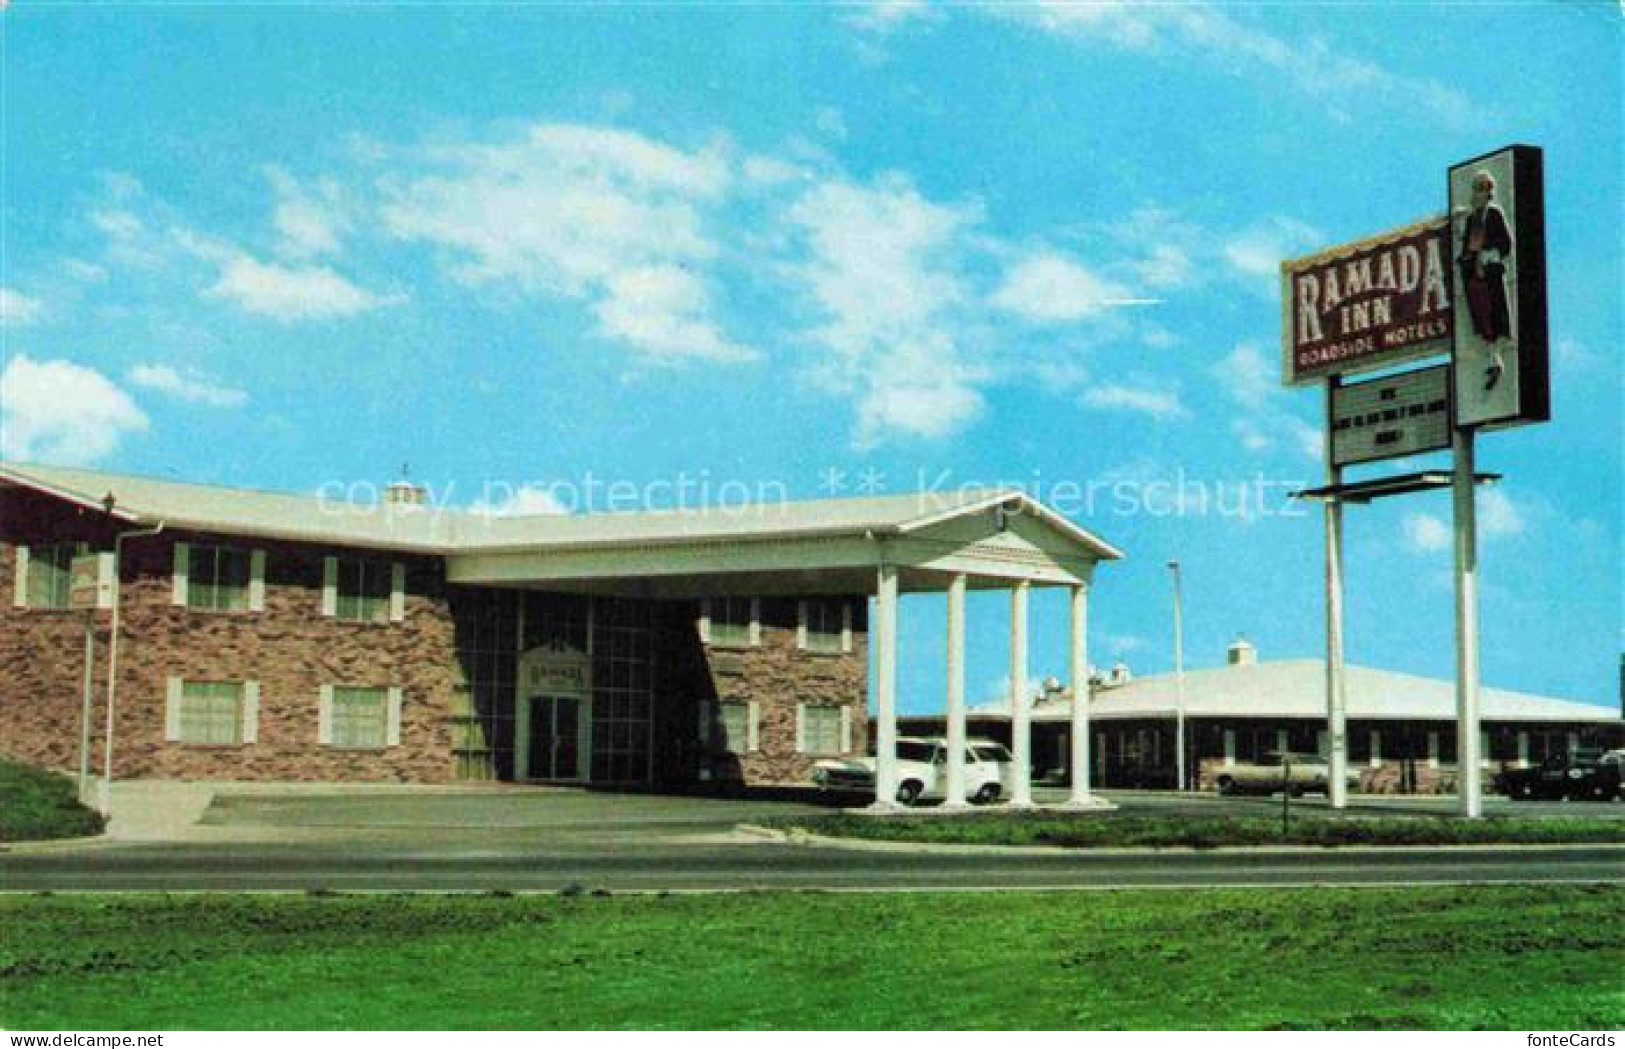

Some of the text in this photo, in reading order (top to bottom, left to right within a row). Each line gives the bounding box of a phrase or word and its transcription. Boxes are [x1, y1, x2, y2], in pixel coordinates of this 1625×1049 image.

[1297, 238, 1449, 344] RAMADA
[1341, 297, 1392, 335] INN
[1299, 317, 1448, 366] ROADSIDE HOTELS
